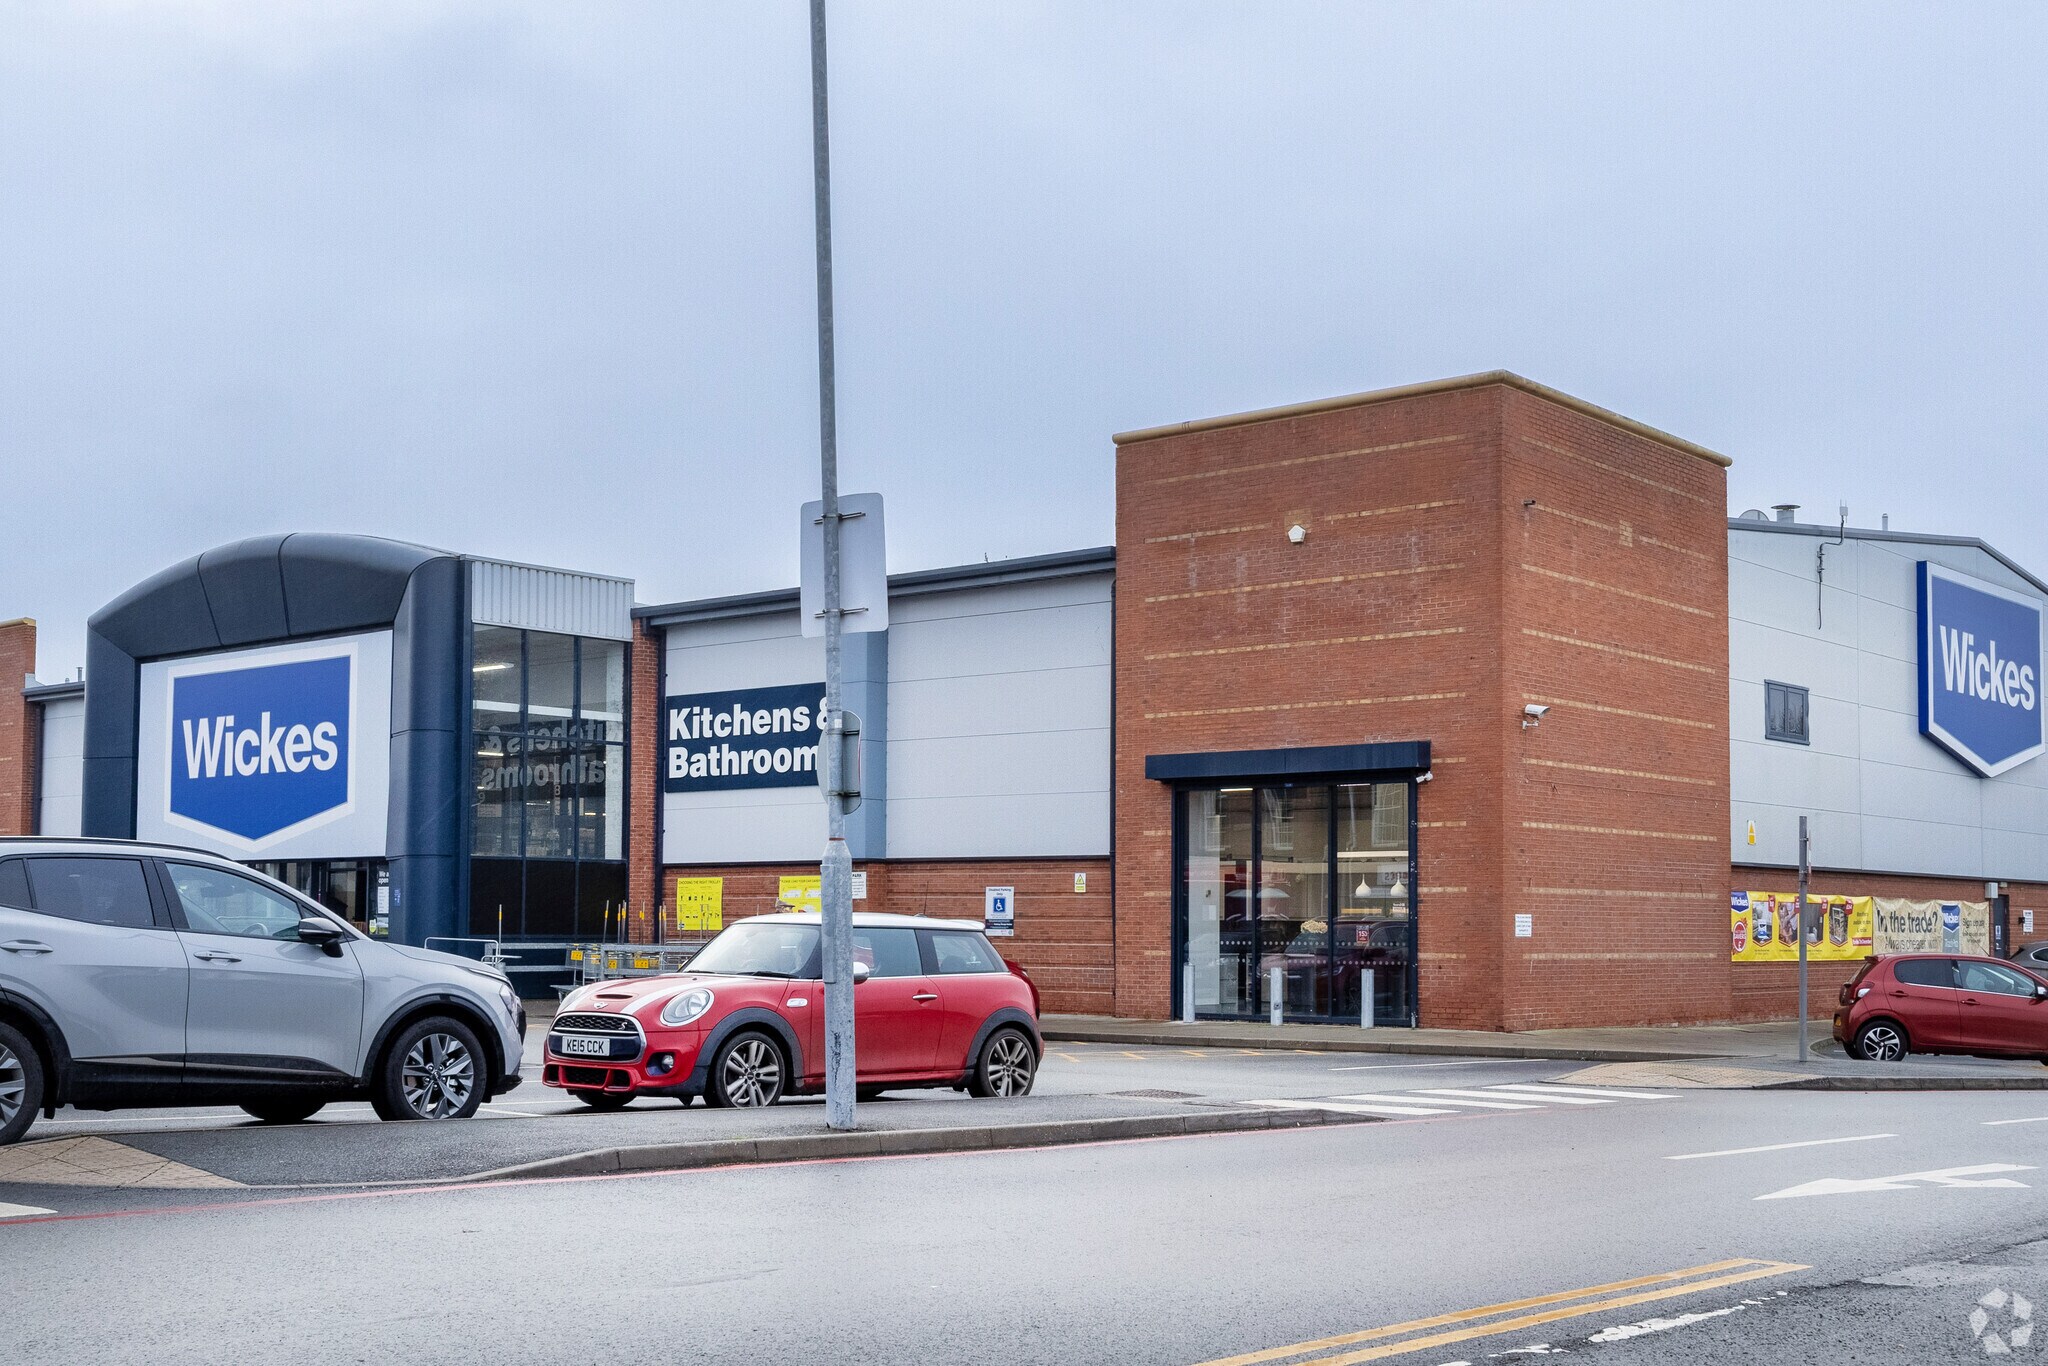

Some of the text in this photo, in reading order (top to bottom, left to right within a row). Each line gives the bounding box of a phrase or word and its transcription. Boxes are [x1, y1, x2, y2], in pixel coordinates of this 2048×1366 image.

[1939, 624, 2035, 711] Wickes
[669, 703, 811, 741] Kitchens
[182, 711, 339, 780] Wickes
[668, 743, 818, 779] Bathroom
[1890, 911, 1906, 933] the
[1907, 910, 1938, 933] trade?
[566, 1038, 604, 1054] KE15 CCK
